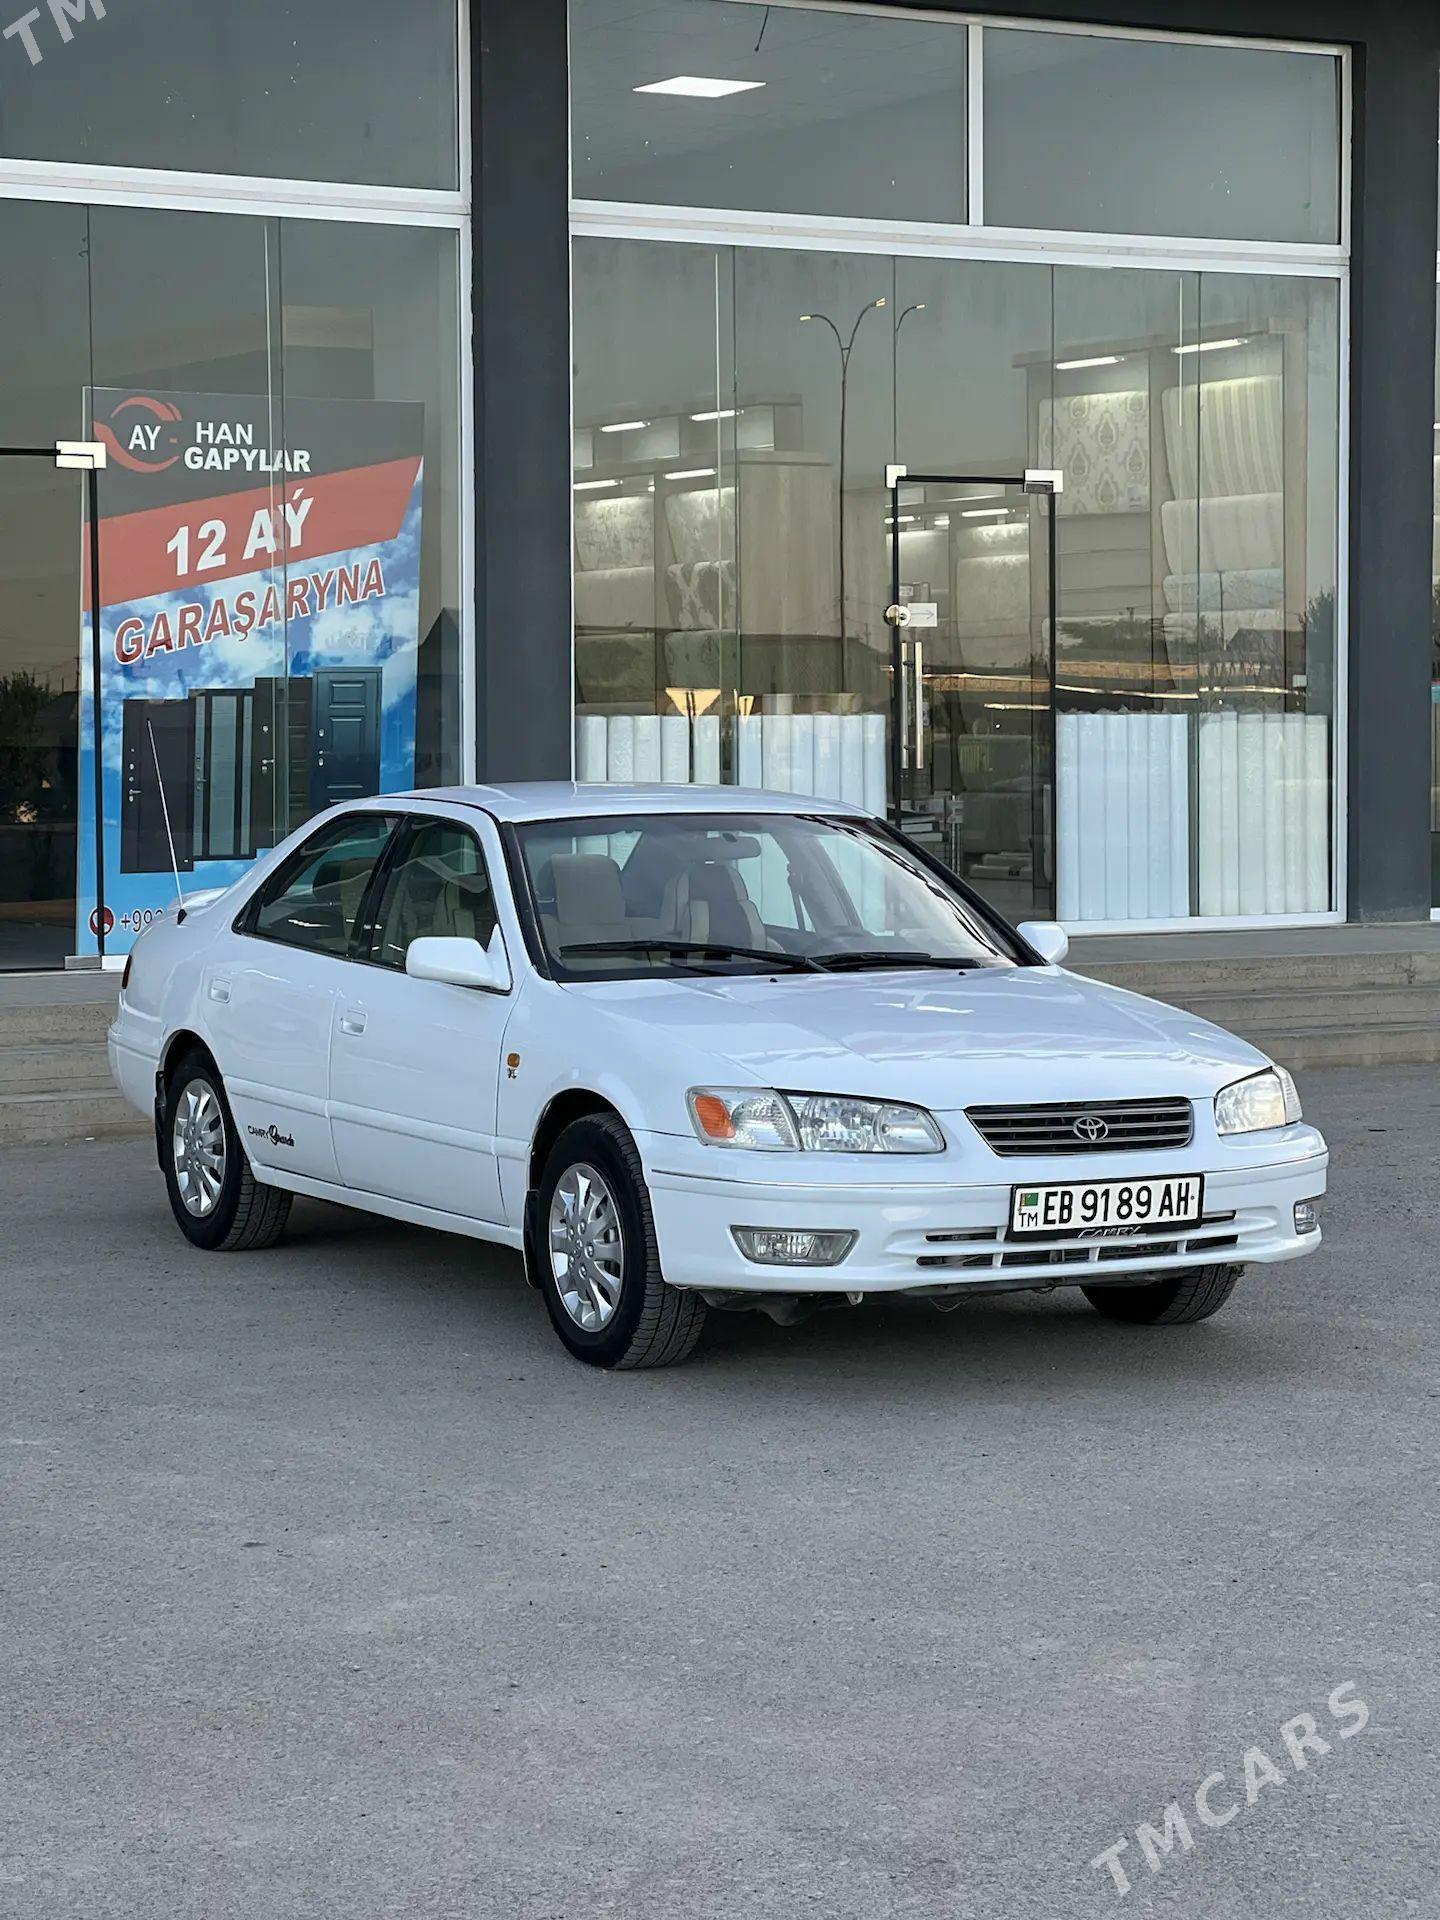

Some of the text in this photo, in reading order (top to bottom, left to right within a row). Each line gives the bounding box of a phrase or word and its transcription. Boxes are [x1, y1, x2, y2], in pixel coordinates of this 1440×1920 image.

[128, 425, 162, 451] AY
[195, 421, 253, 446] HAN
[184, 446, 312, 473] GAPYLAR
[166, 487, 315, 577] 12 AÝ
[112, 556, 387, 665] GARAŞARYNA
[1042, 1182, 1191, 1226] EB 9189 AH
[1018, 1211, 1039, 1228] TM
